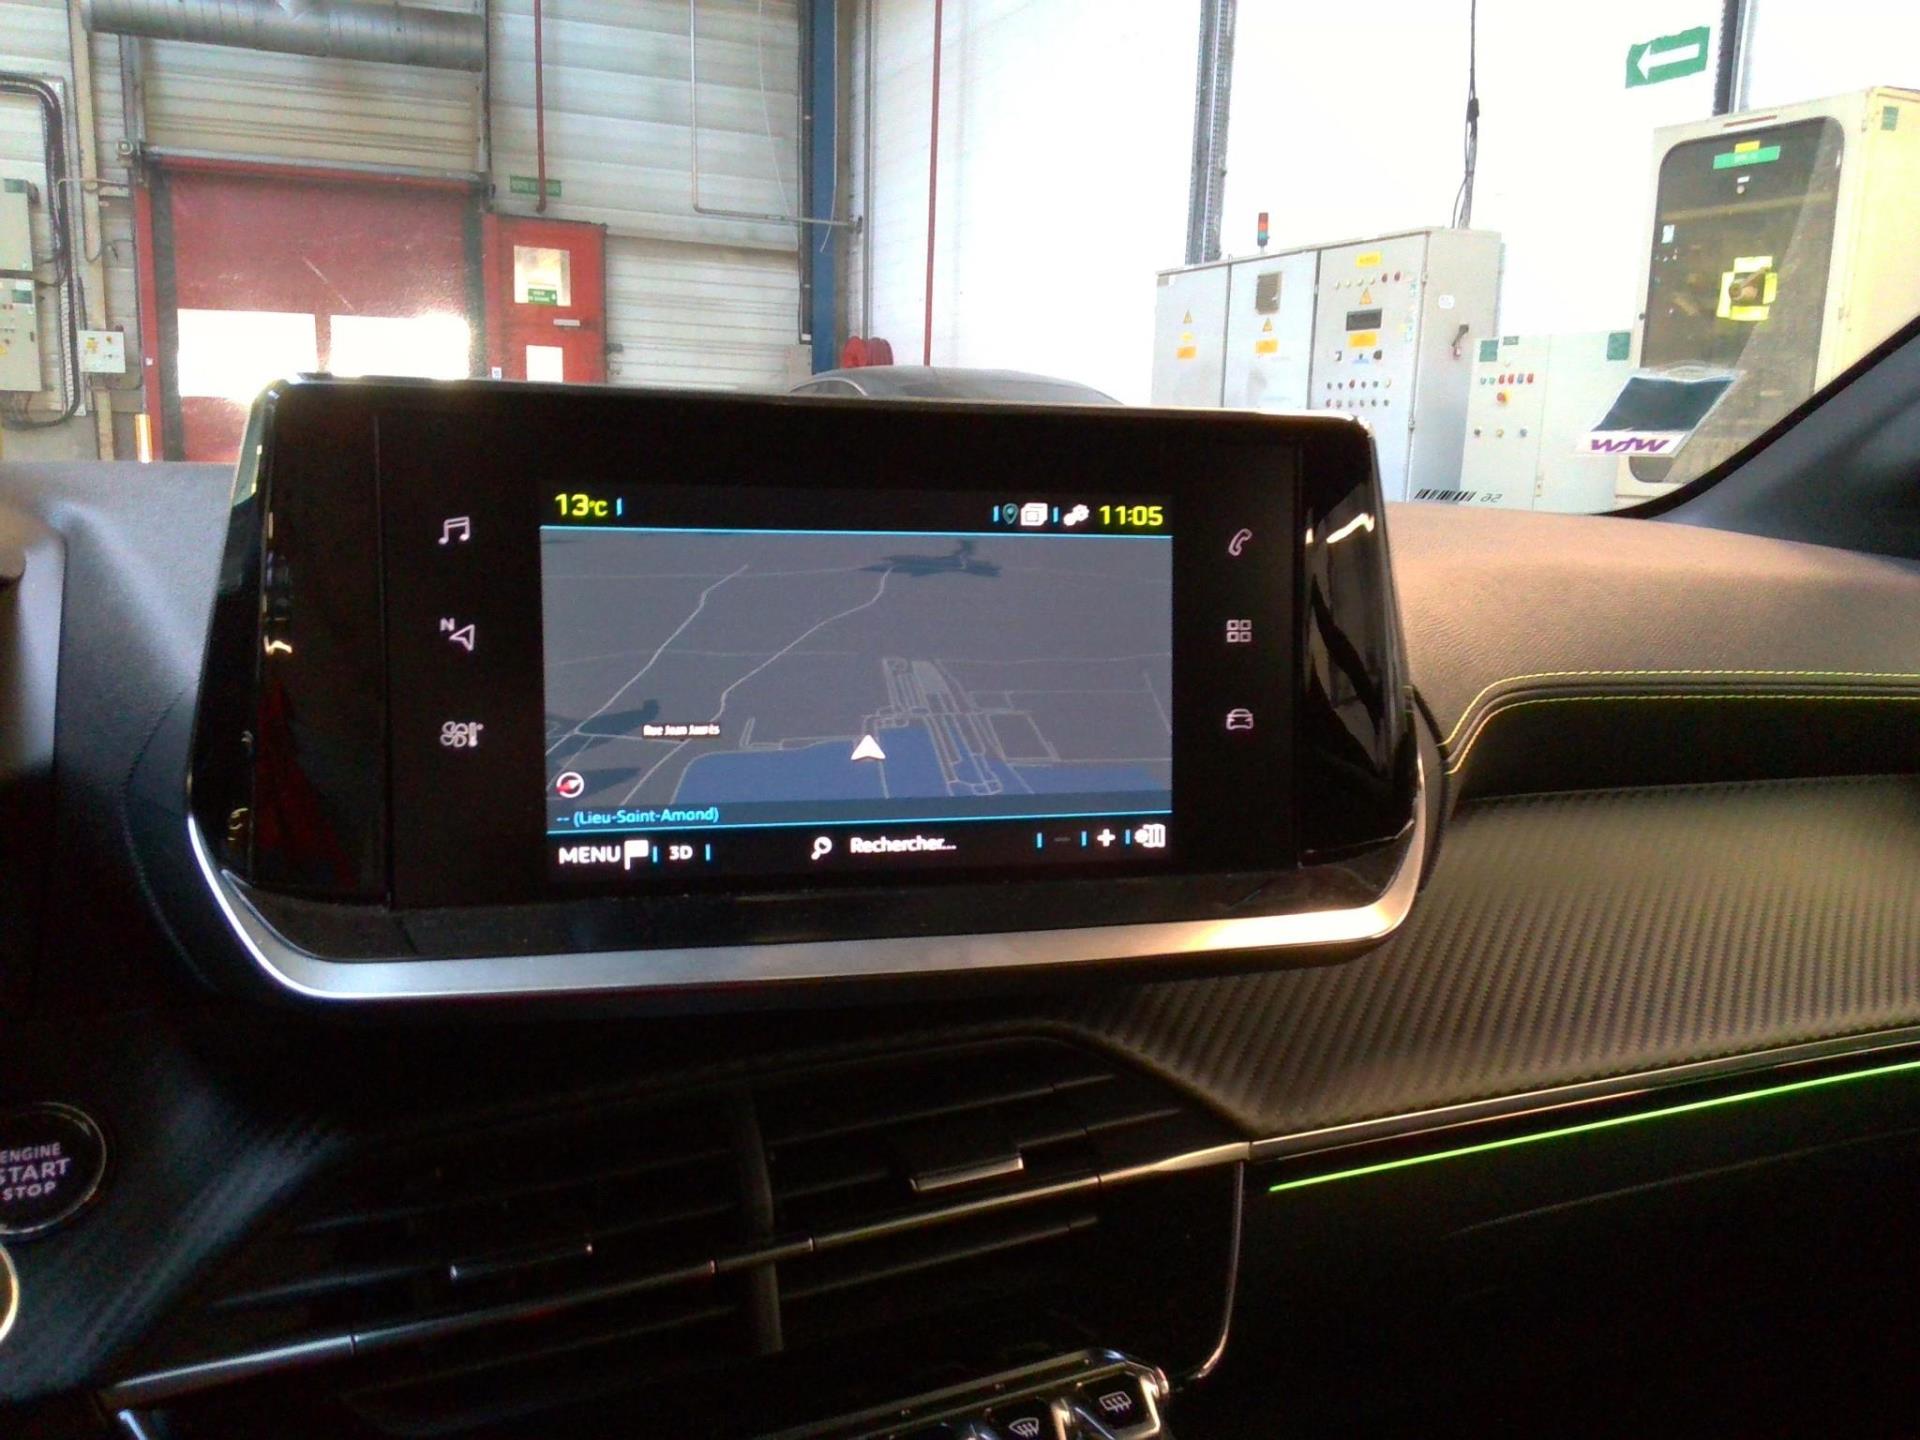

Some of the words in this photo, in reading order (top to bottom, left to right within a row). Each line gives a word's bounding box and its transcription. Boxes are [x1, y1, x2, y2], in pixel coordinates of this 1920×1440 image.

[1099, 505, 1163, 526] 11:05
[558, 845, 621, 865] MENU
[669, 845, 693, 861] 3D
[2, 1180, 56, 1201] STOP
